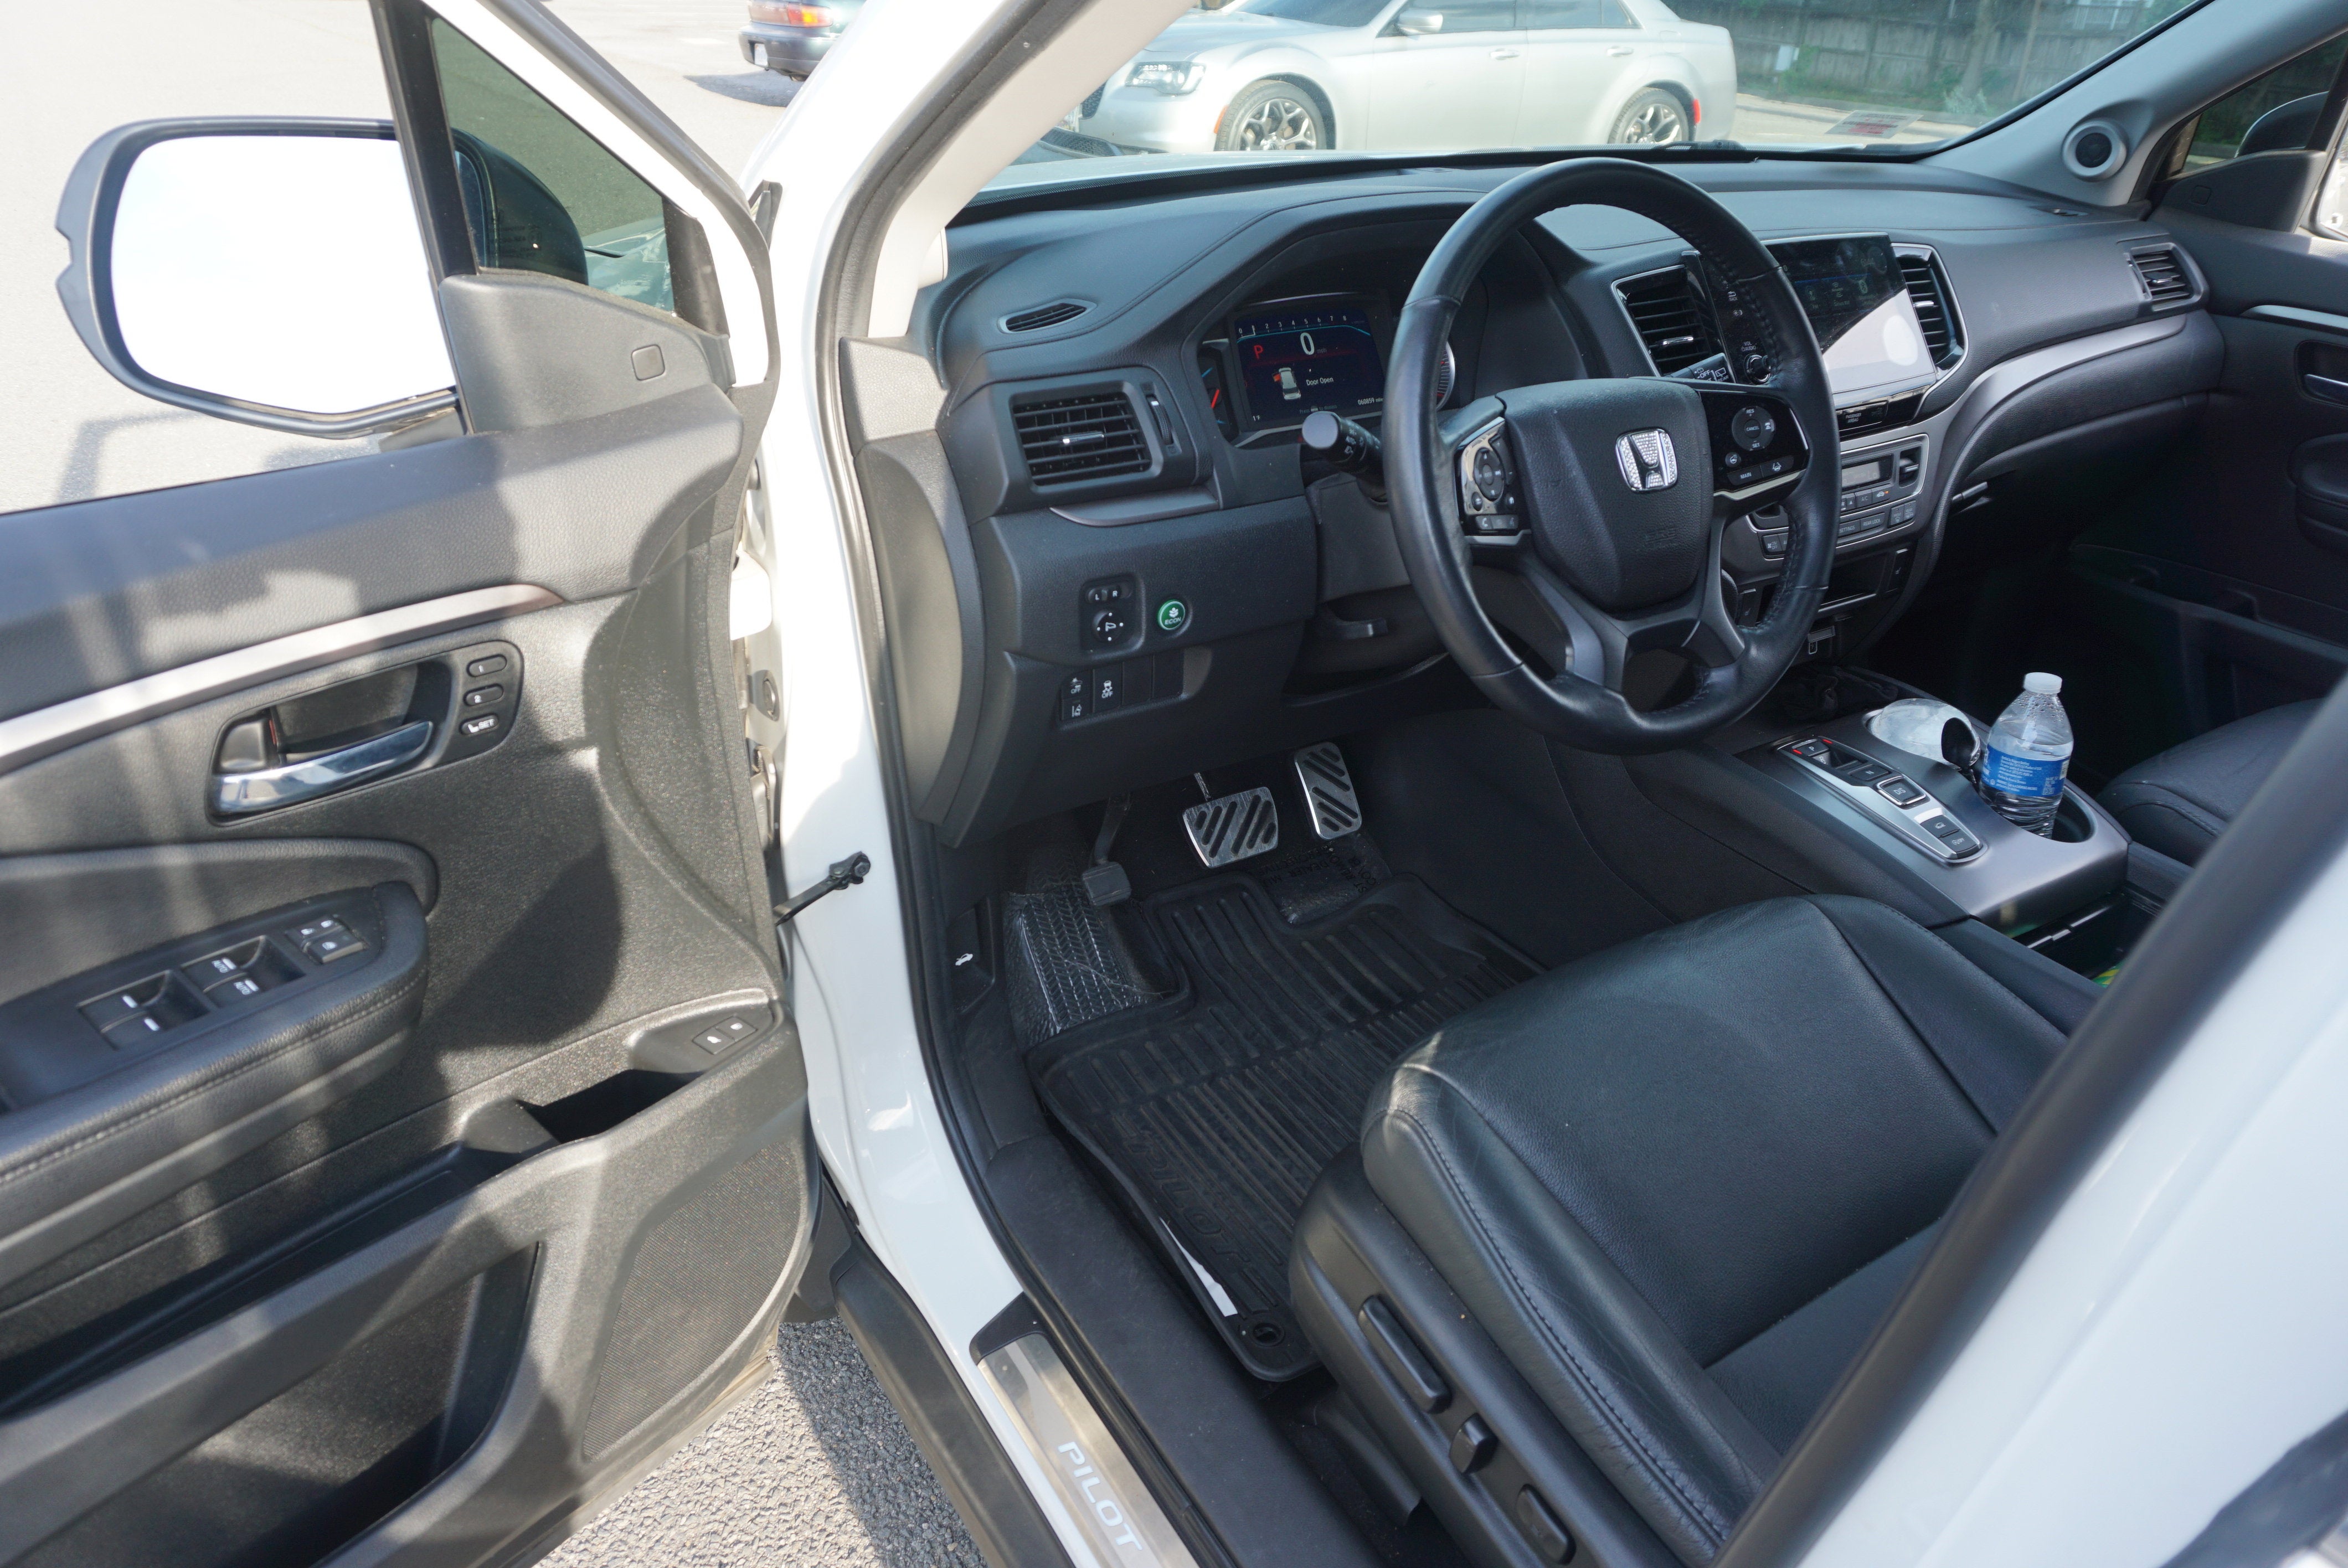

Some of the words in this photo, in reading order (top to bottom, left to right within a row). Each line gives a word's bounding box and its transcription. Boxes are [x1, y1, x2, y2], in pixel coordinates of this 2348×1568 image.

[1300, 332, 1315, 355] 0
[1253, 344, 1264, 359] P
[1700, 369, 1711, 378] OFF
[1358, 397, 1375, 405] 060859
[1839, 525, 1855, 533] SETTINGS
[1165, 616, 1181, 625] ECON
[474, 695, 482, 703] 2
[478, 719, 495, 729] SET
[1289, 859, 1330, 878] DEALER
[212, 960, 230, 973] AUTO
[233, 982, 252, 995] AUTO
[1124, 1141, 1252, 1263] PILOT
[1058, 1441, 1142, 1551] PILOT
